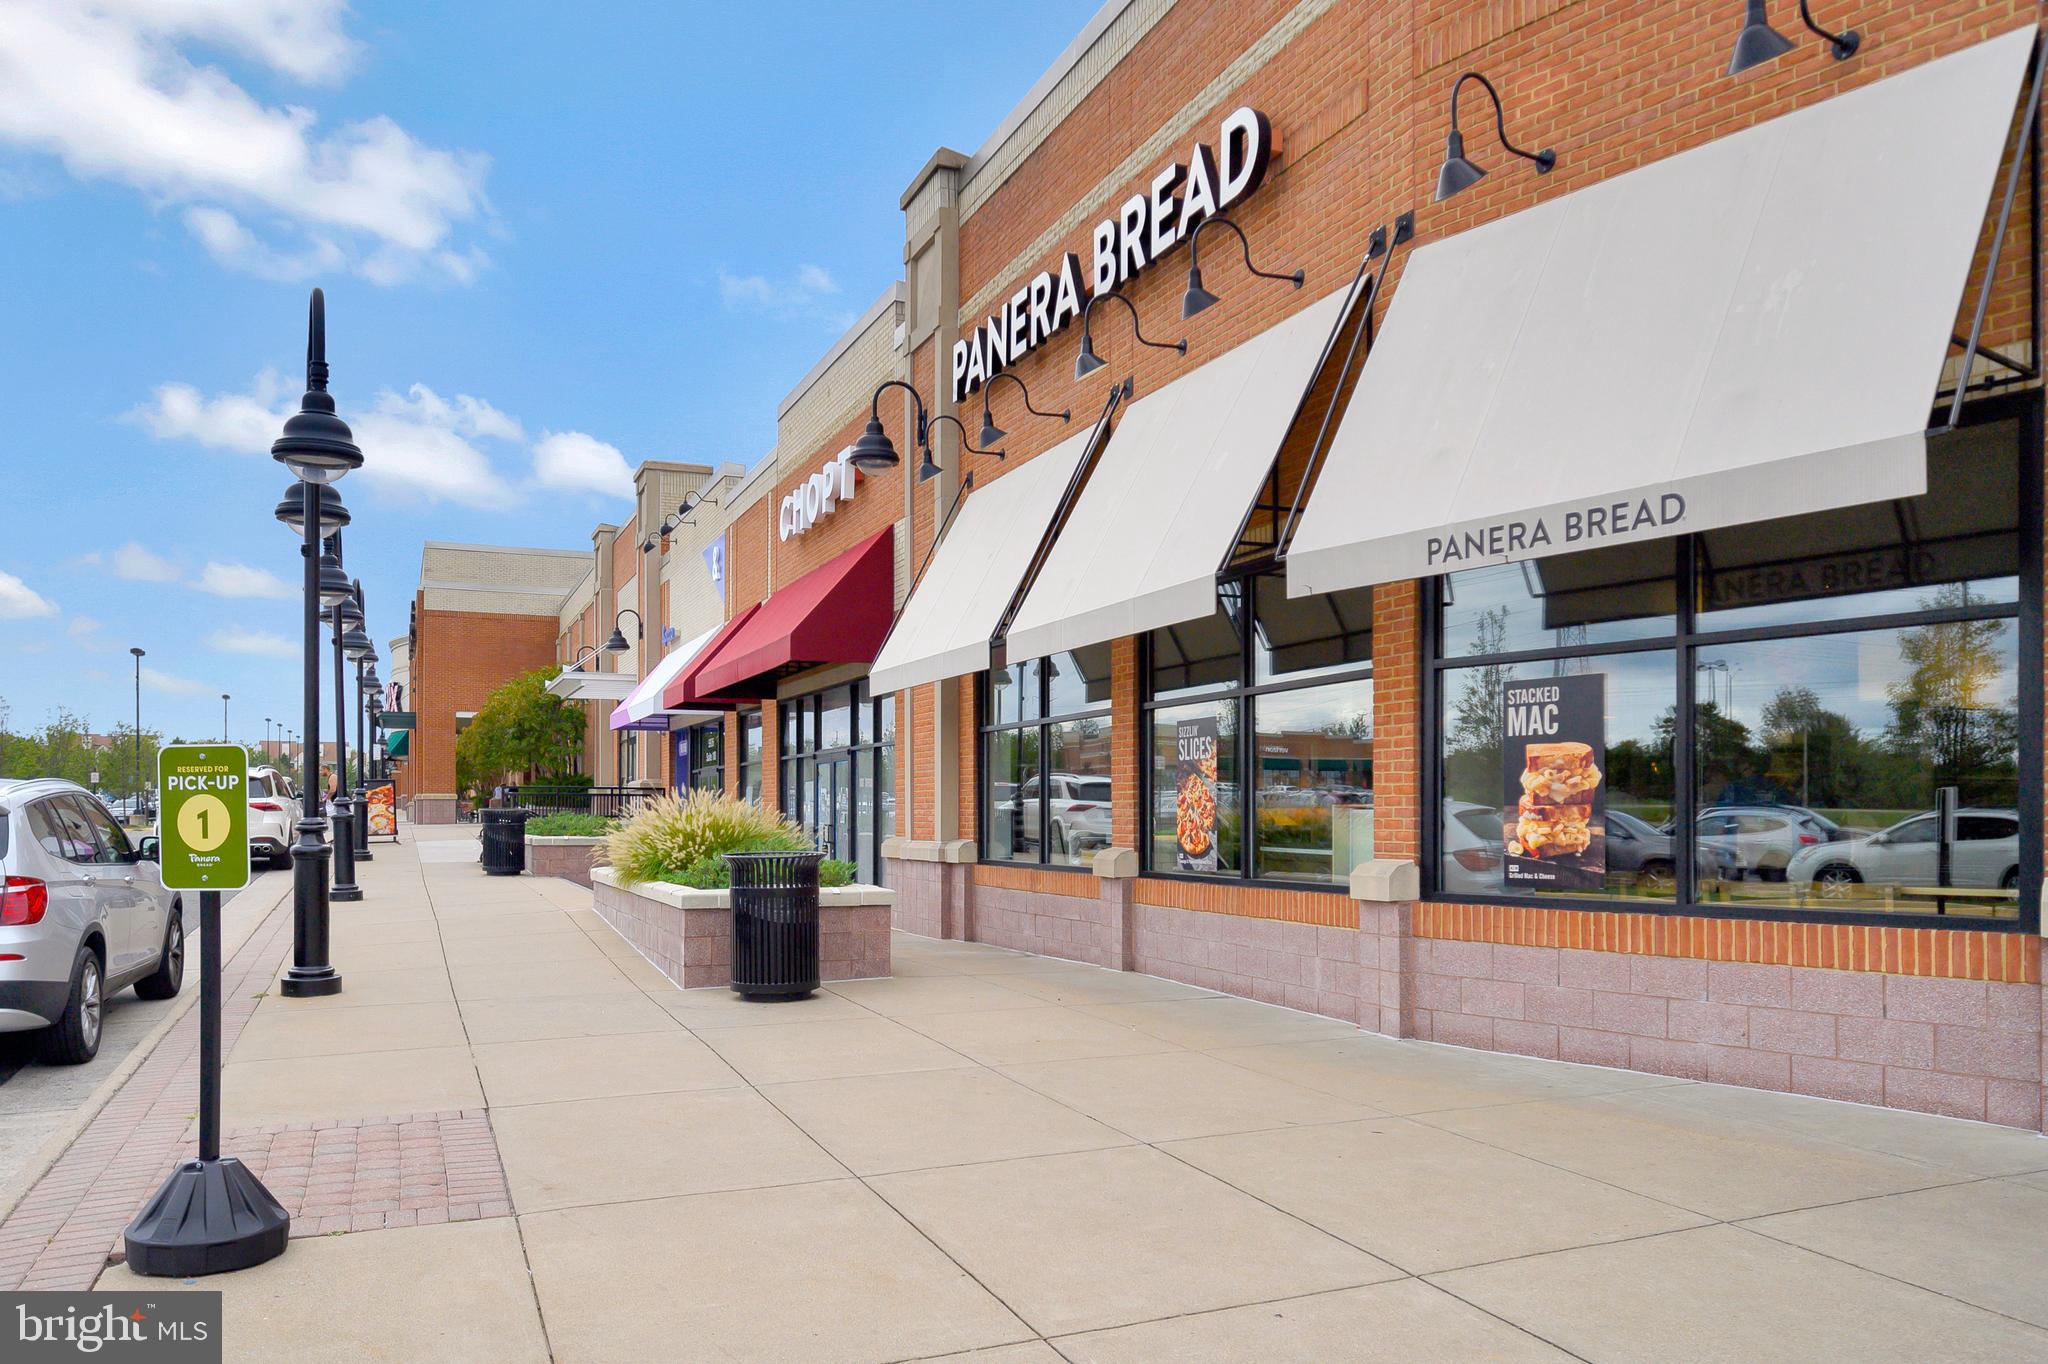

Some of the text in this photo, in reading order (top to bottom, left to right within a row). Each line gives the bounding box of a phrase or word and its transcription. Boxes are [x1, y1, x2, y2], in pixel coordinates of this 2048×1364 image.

[953, 106, 1265, 403] PANERA BREAD
[780, 444, 857, 542] CHOPT
[1427, 492, 1686, 565] PANERA BREAD
[1507, 686, 1560, 705] STACKED
[1507, 703, 1559, 737] MAC
[1178, 735, 1212, 761] SLICES
[168, 775, 239, 791] PICK-UP
[214, 765, 229, 773] FOR
[196, 808, 209, 839] 1
[188, 853, 221, 863] Panera
